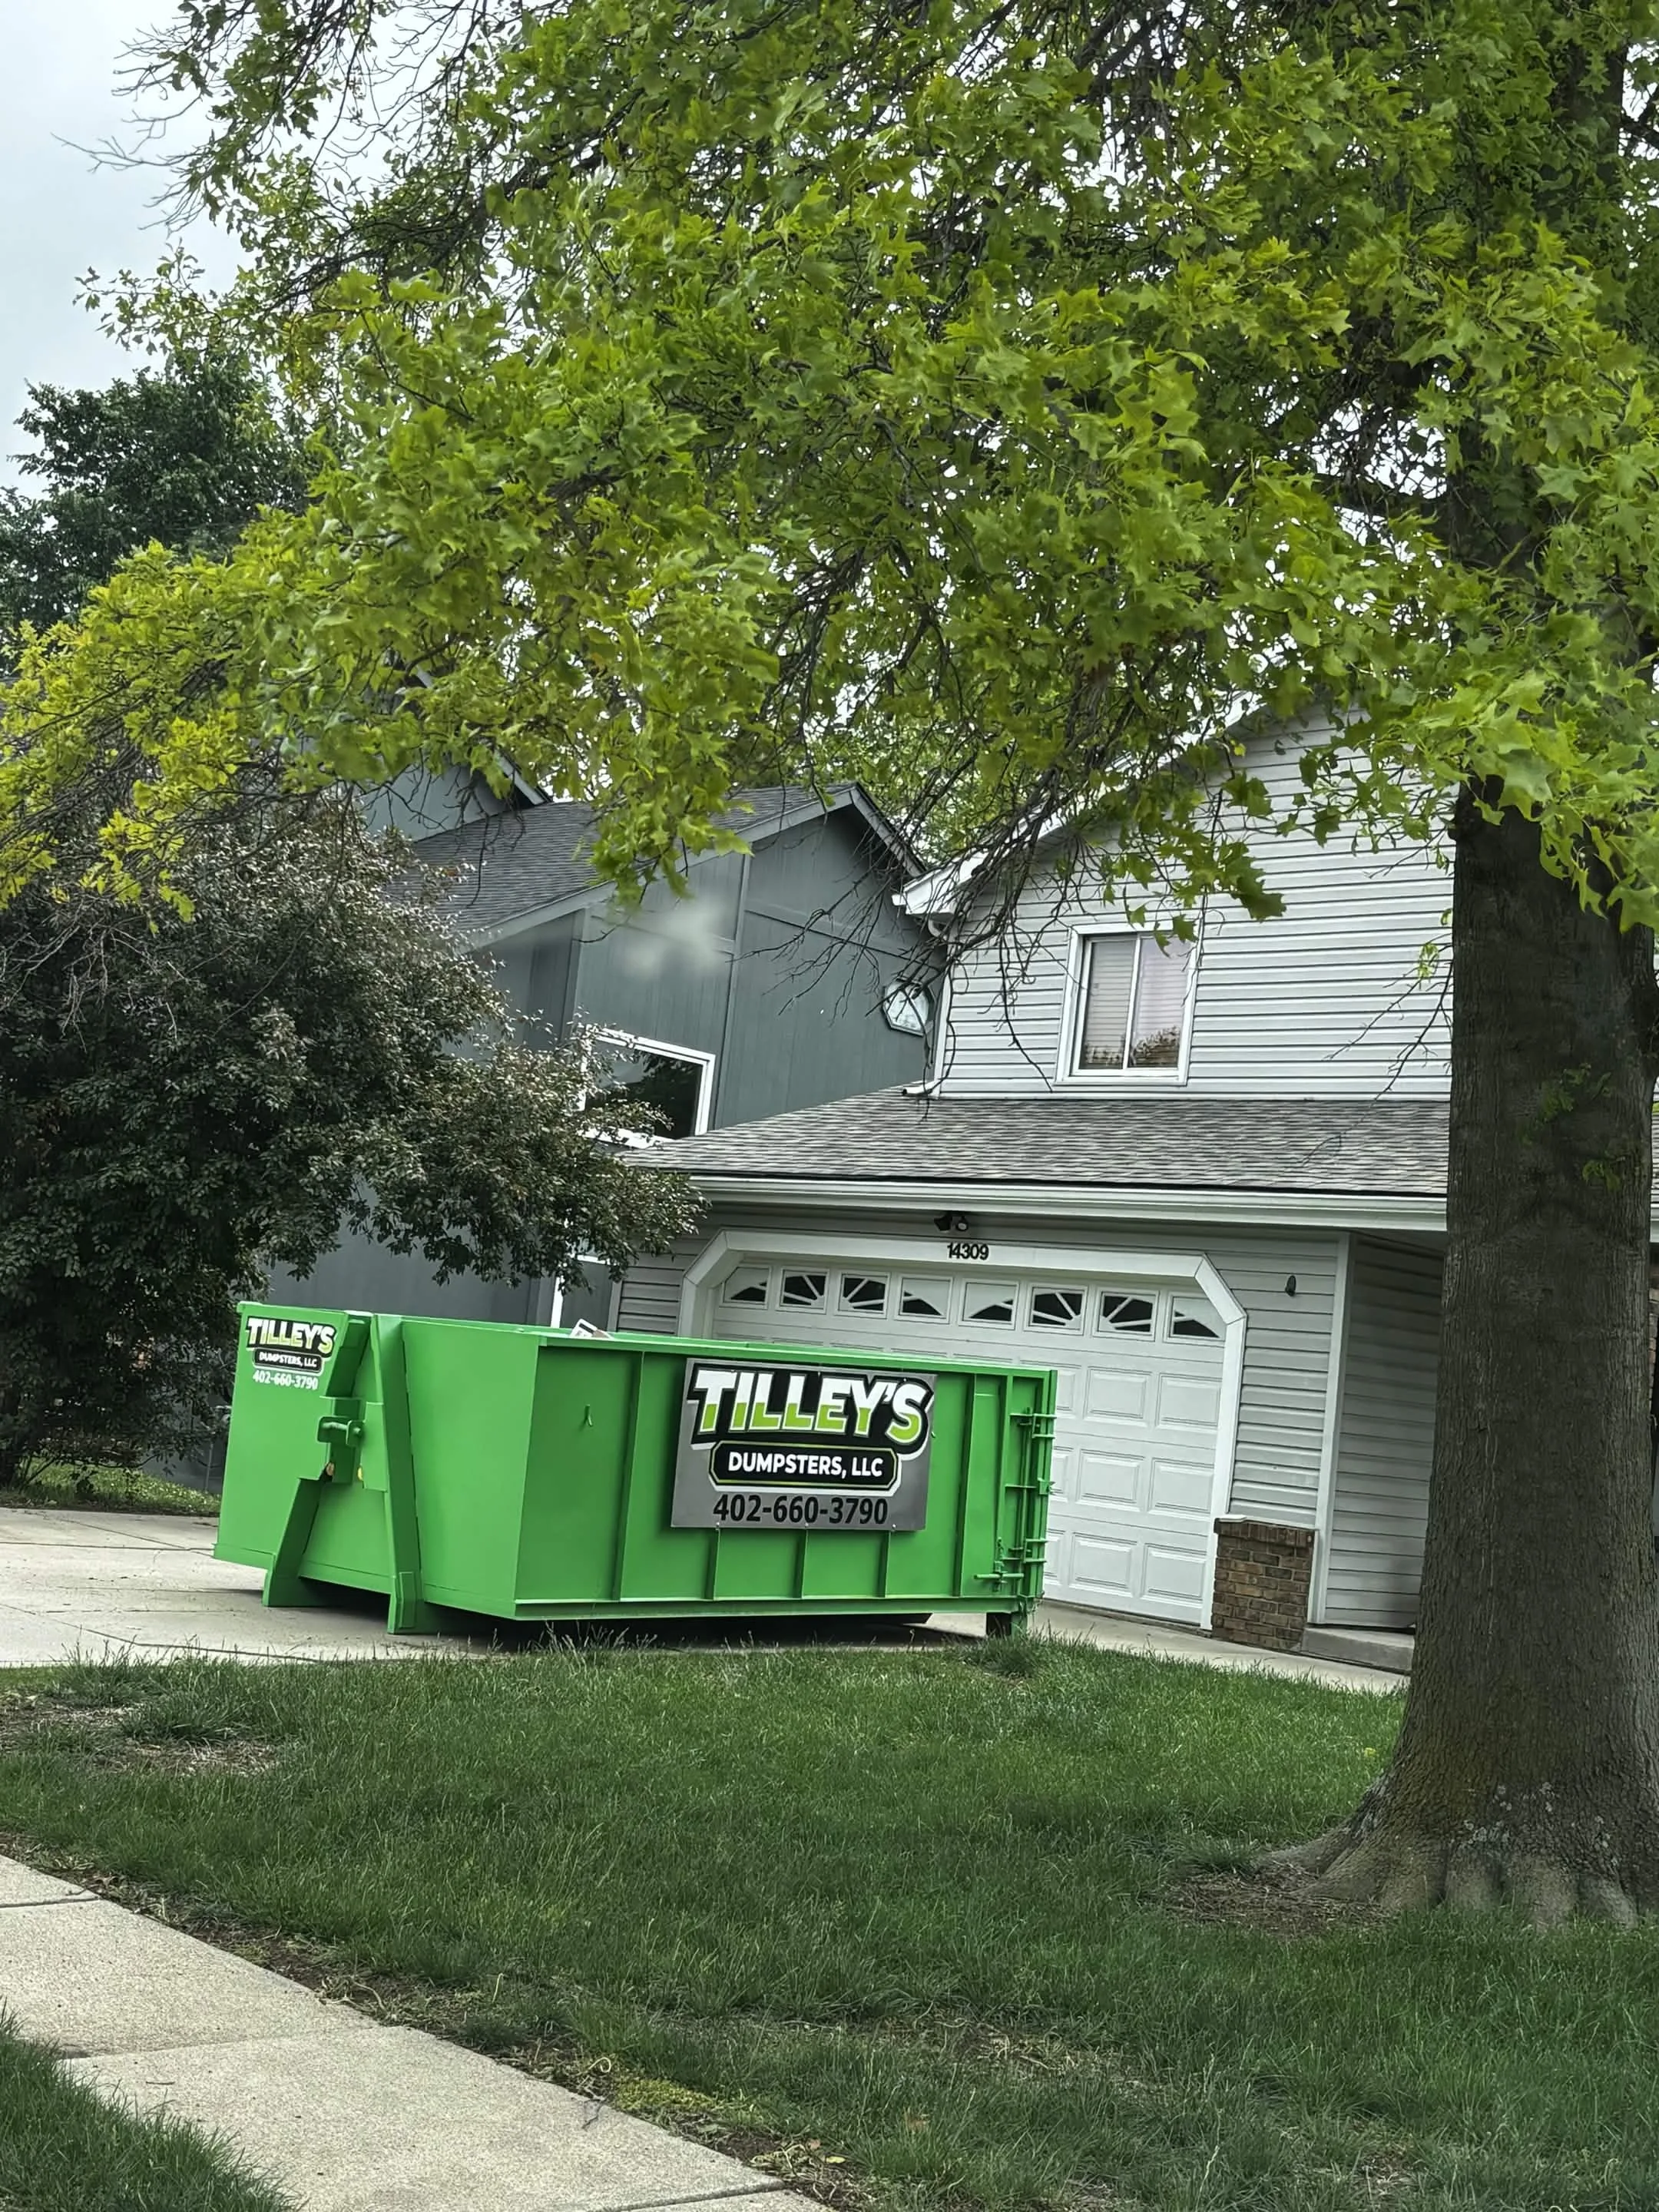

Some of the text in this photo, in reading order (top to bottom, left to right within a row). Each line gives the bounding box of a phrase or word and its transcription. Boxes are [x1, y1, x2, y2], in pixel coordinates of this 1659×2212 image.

[947, 1243, 989, 1260] 14309
[247, 1317, 335, 1354] TILLEY'S
[259, 1352, 317, 1367] DUMPSTERS, LLC
[253, 1370, 319, 1390] 402-660-3790
[693, 1369, 927, 1444] TILLEY'S
[728, 1452, 883, 1479] DUMPSTERS, LLC
[714, 1494, 888, 1525] 402-660-3790
